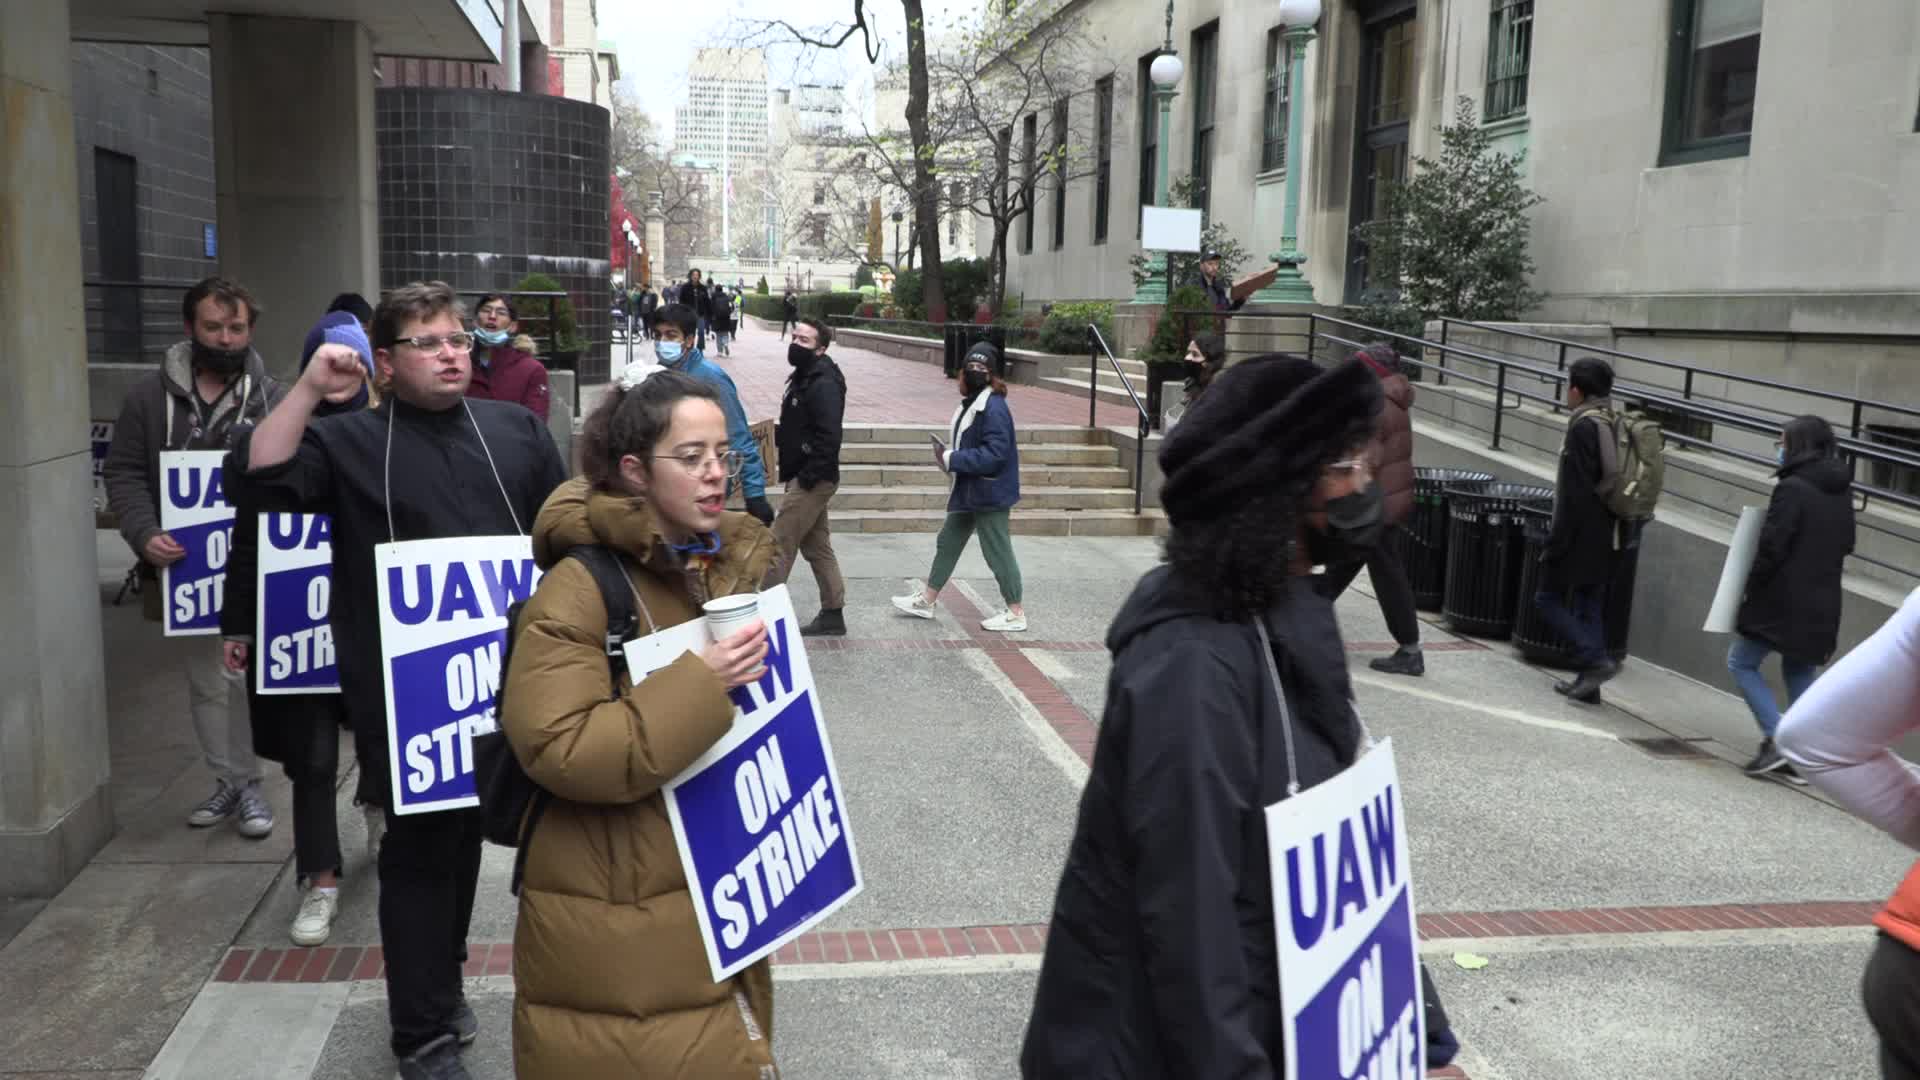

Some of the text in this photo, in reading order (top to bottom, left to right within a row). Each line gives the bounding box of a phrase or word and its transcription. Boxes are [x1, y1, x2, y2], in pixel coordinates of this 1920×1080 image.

[168, 467, 227, 509] UA
[206, 527, 233, 570] O
[268, 512, 332, 551] UA
[307, 575, 330, 621] O
[388, 559, 534, 626] UAW
[270, 623, 336, 681] STR
[446, 640, 501, 712] ON
[734, 734, 792, 835] ON
[711, 775, 840, 950] STRIKE
[1285, 784, 1396, 951] UAW
[1338, 943, 1384, 1079] ON
